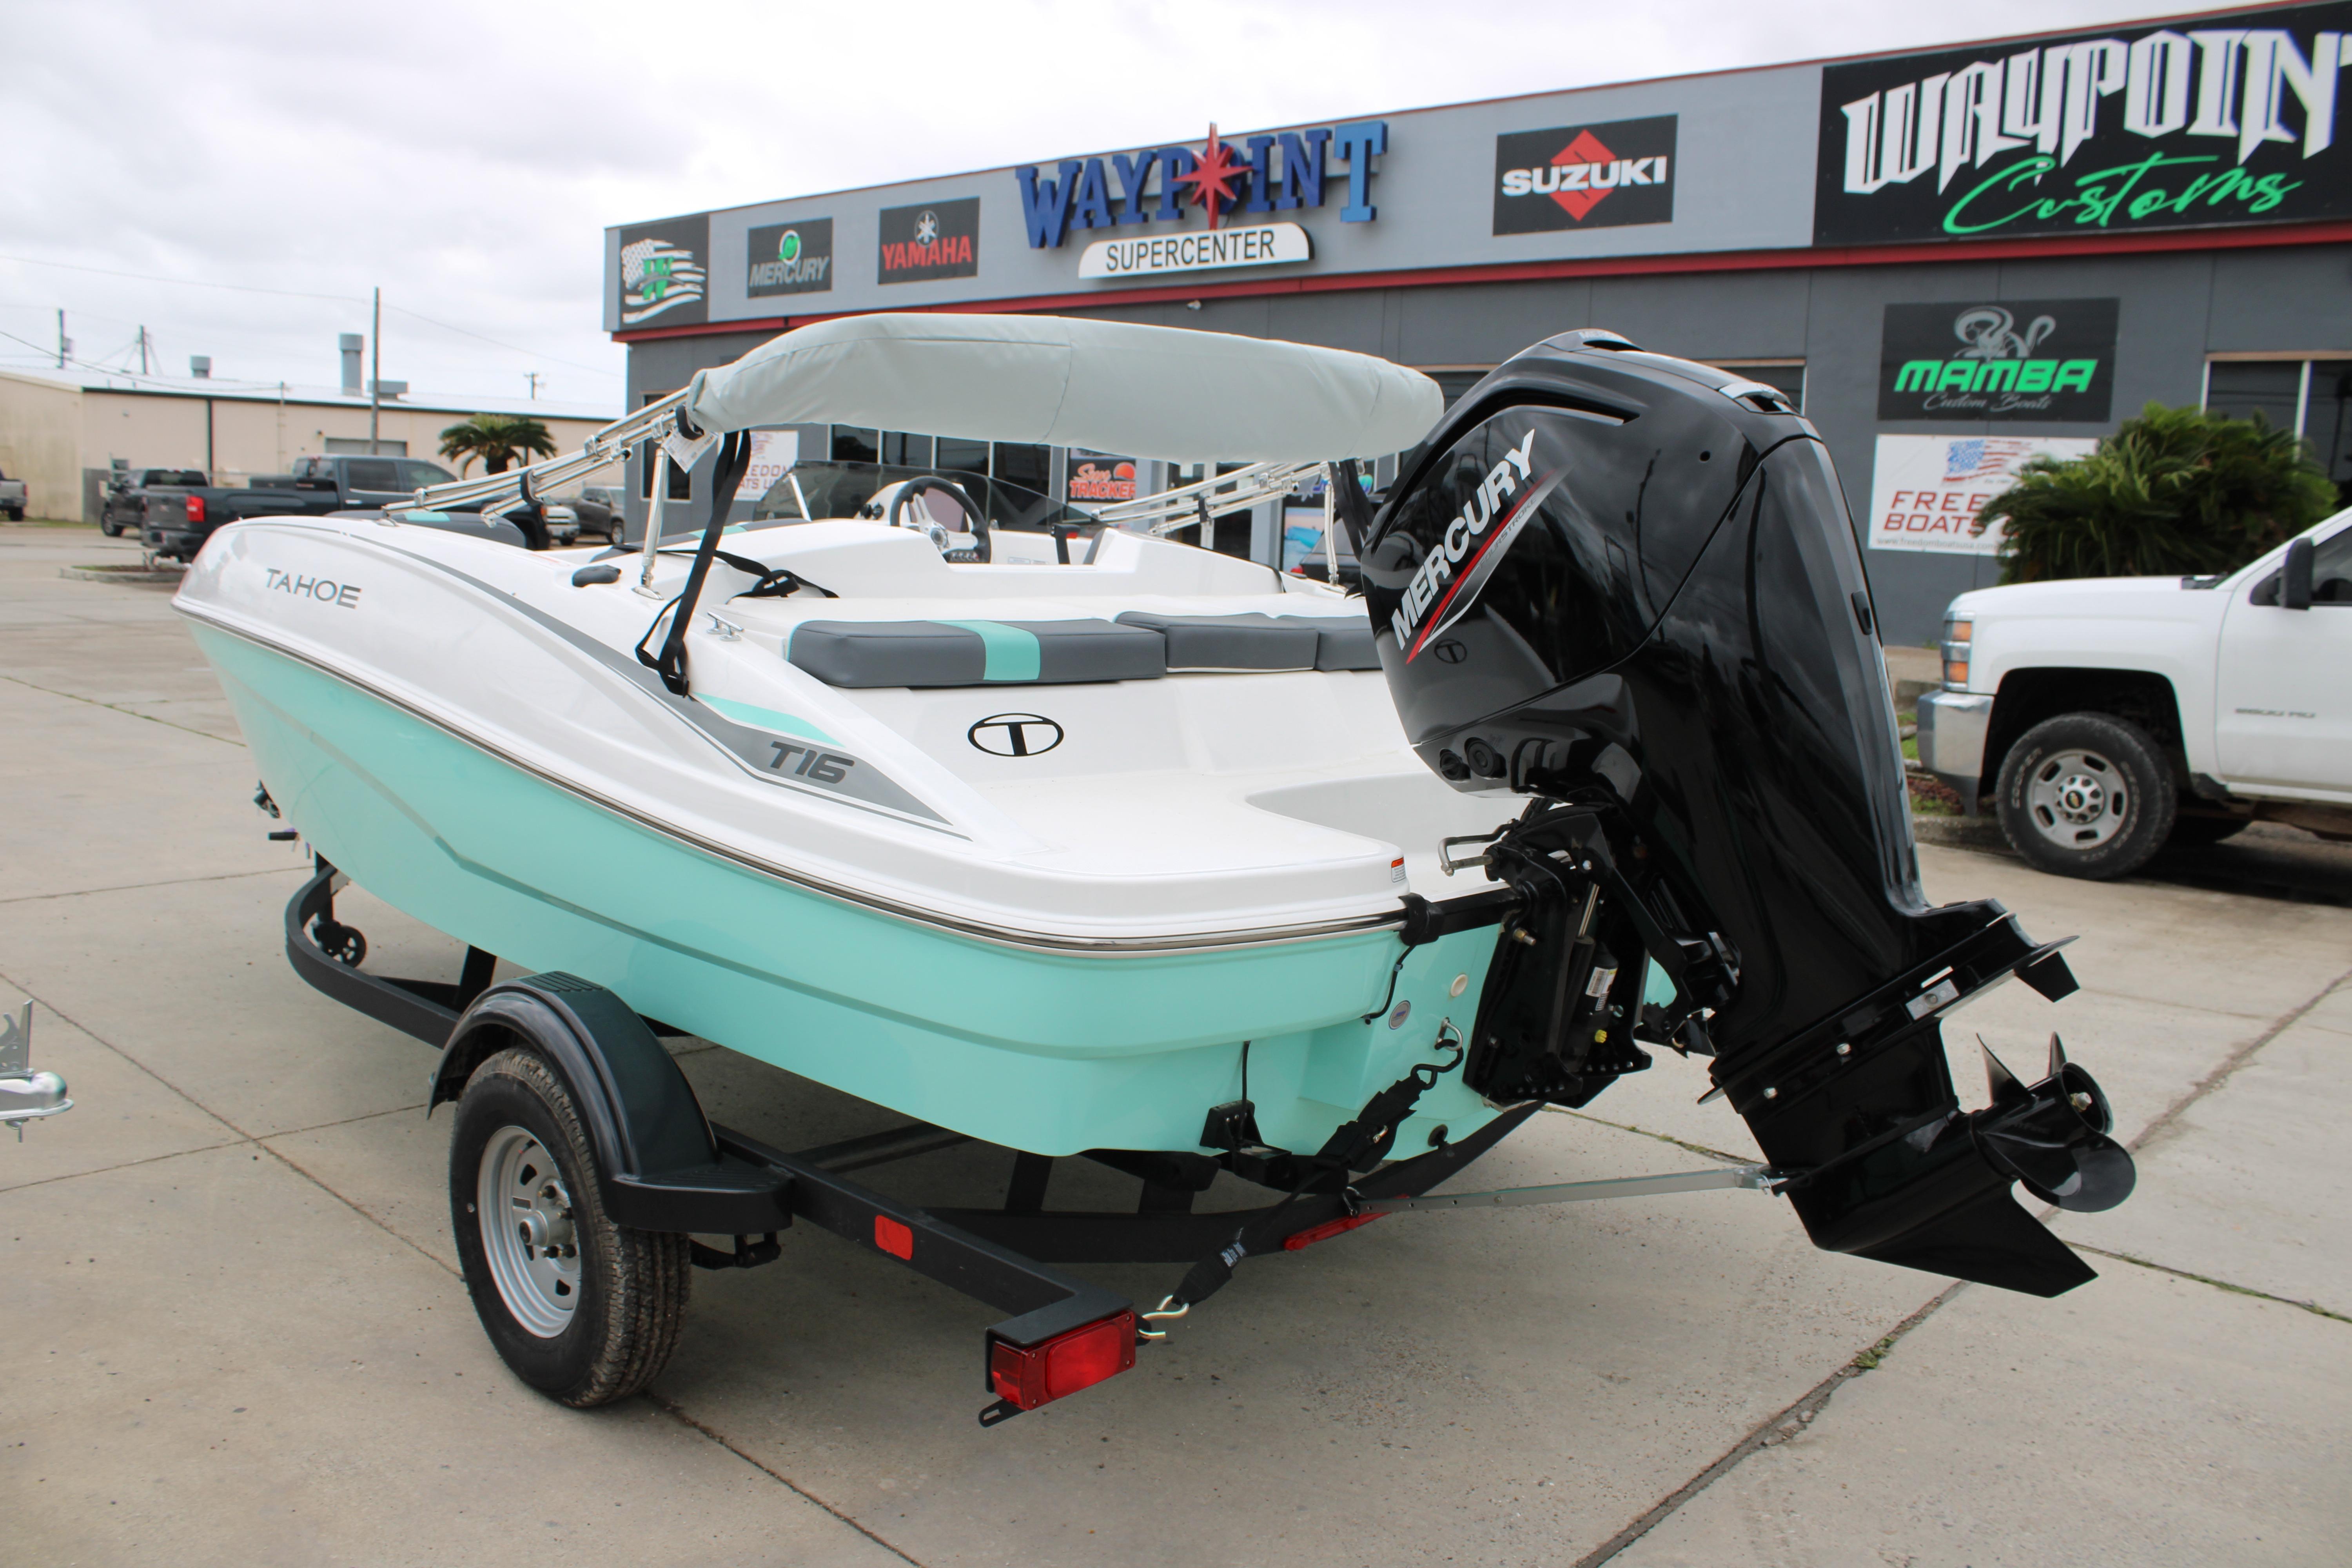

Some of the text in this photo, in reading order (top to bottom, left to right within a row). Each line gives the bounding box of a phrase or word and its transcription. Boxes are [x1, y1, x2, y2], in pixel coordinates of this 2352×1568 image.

[1840, 29, 2352, 196] WAYPOIN
[1015, 120, 1388, 249] WAYPOINT
[1501, 156, 1668, 196] SUZUKI
[1943, 151, 2304, 234] Customs
[749, 255, 830, 288] MERCURY
[881, 235, 972, 271] YAMAHA
[1105, 230, 1275, 272] SUPERCENTER
[1894, 359, 2098, 392] MAMBA
[1923, 392, 2053, 412] Custom Boats
[1073, 463, 1111, 481] Sun
[1891, 490, 1991, 513] FREE
[1391, 428, 1535, 650] MERCURY
[1478, 495, 1537, 568] FOURSTROKE
[266, 568, 362, 610] TAHOE
[770, 741, 855, 784] T16
